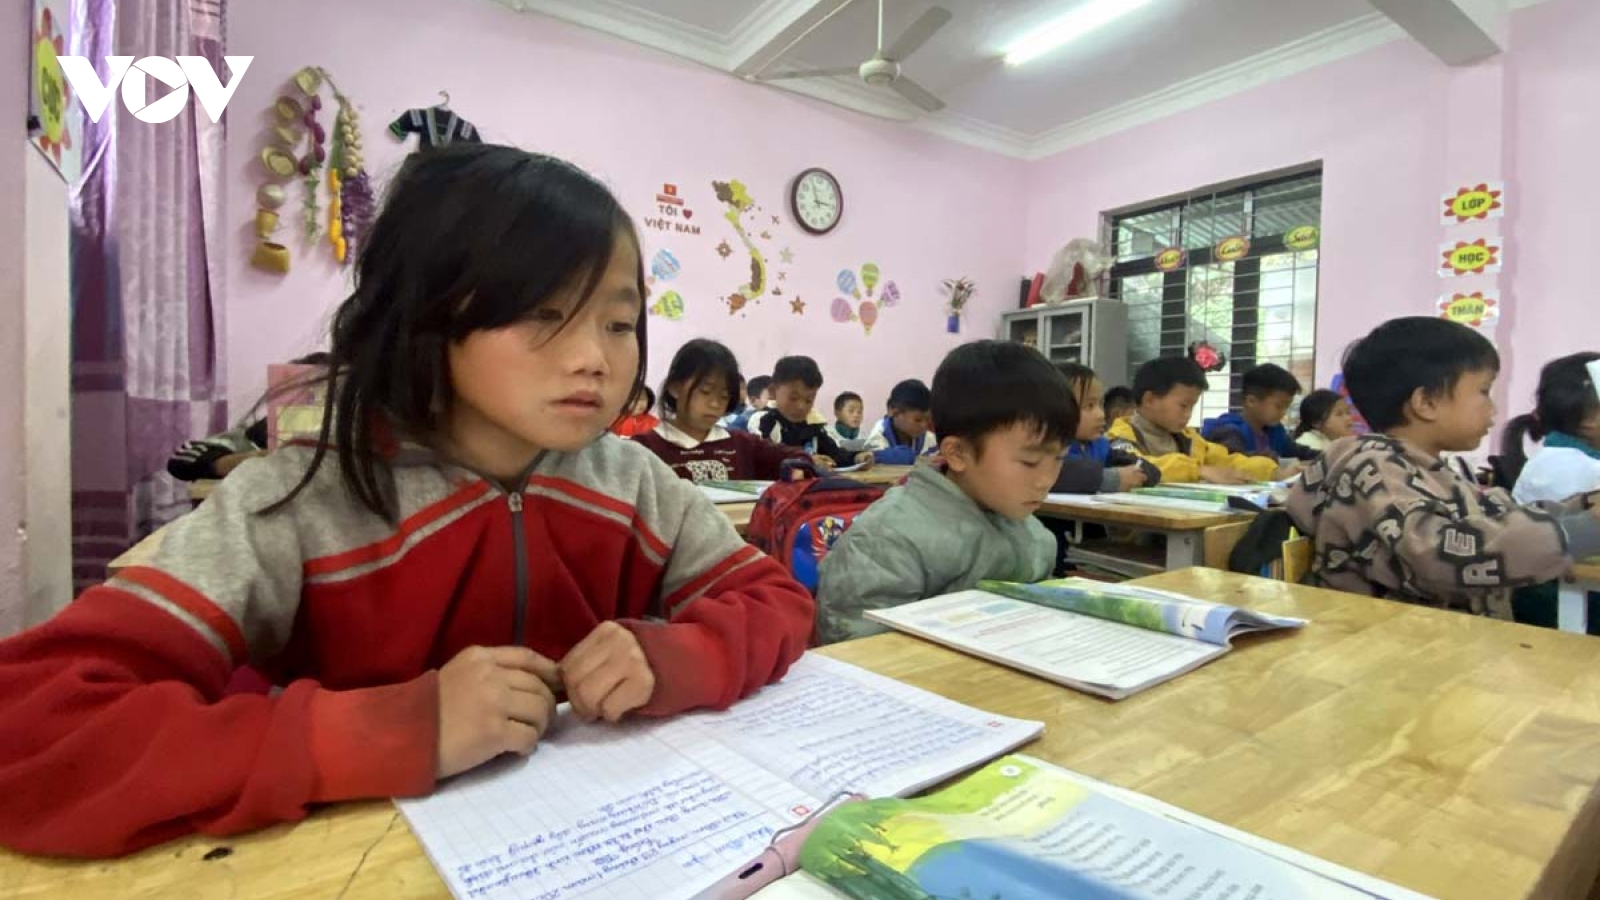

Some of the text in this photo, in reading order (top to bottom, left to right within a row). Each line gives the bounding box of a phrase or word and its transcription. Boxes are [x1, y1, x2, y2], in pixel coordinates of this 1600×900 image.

[658, 205, 677, 216] TÔI
[1461, 195, 1485, 211] LỚP
[644, 217, 700, 235] VIỆT NAM
[1458, 251, 1484, 265] HỌC
